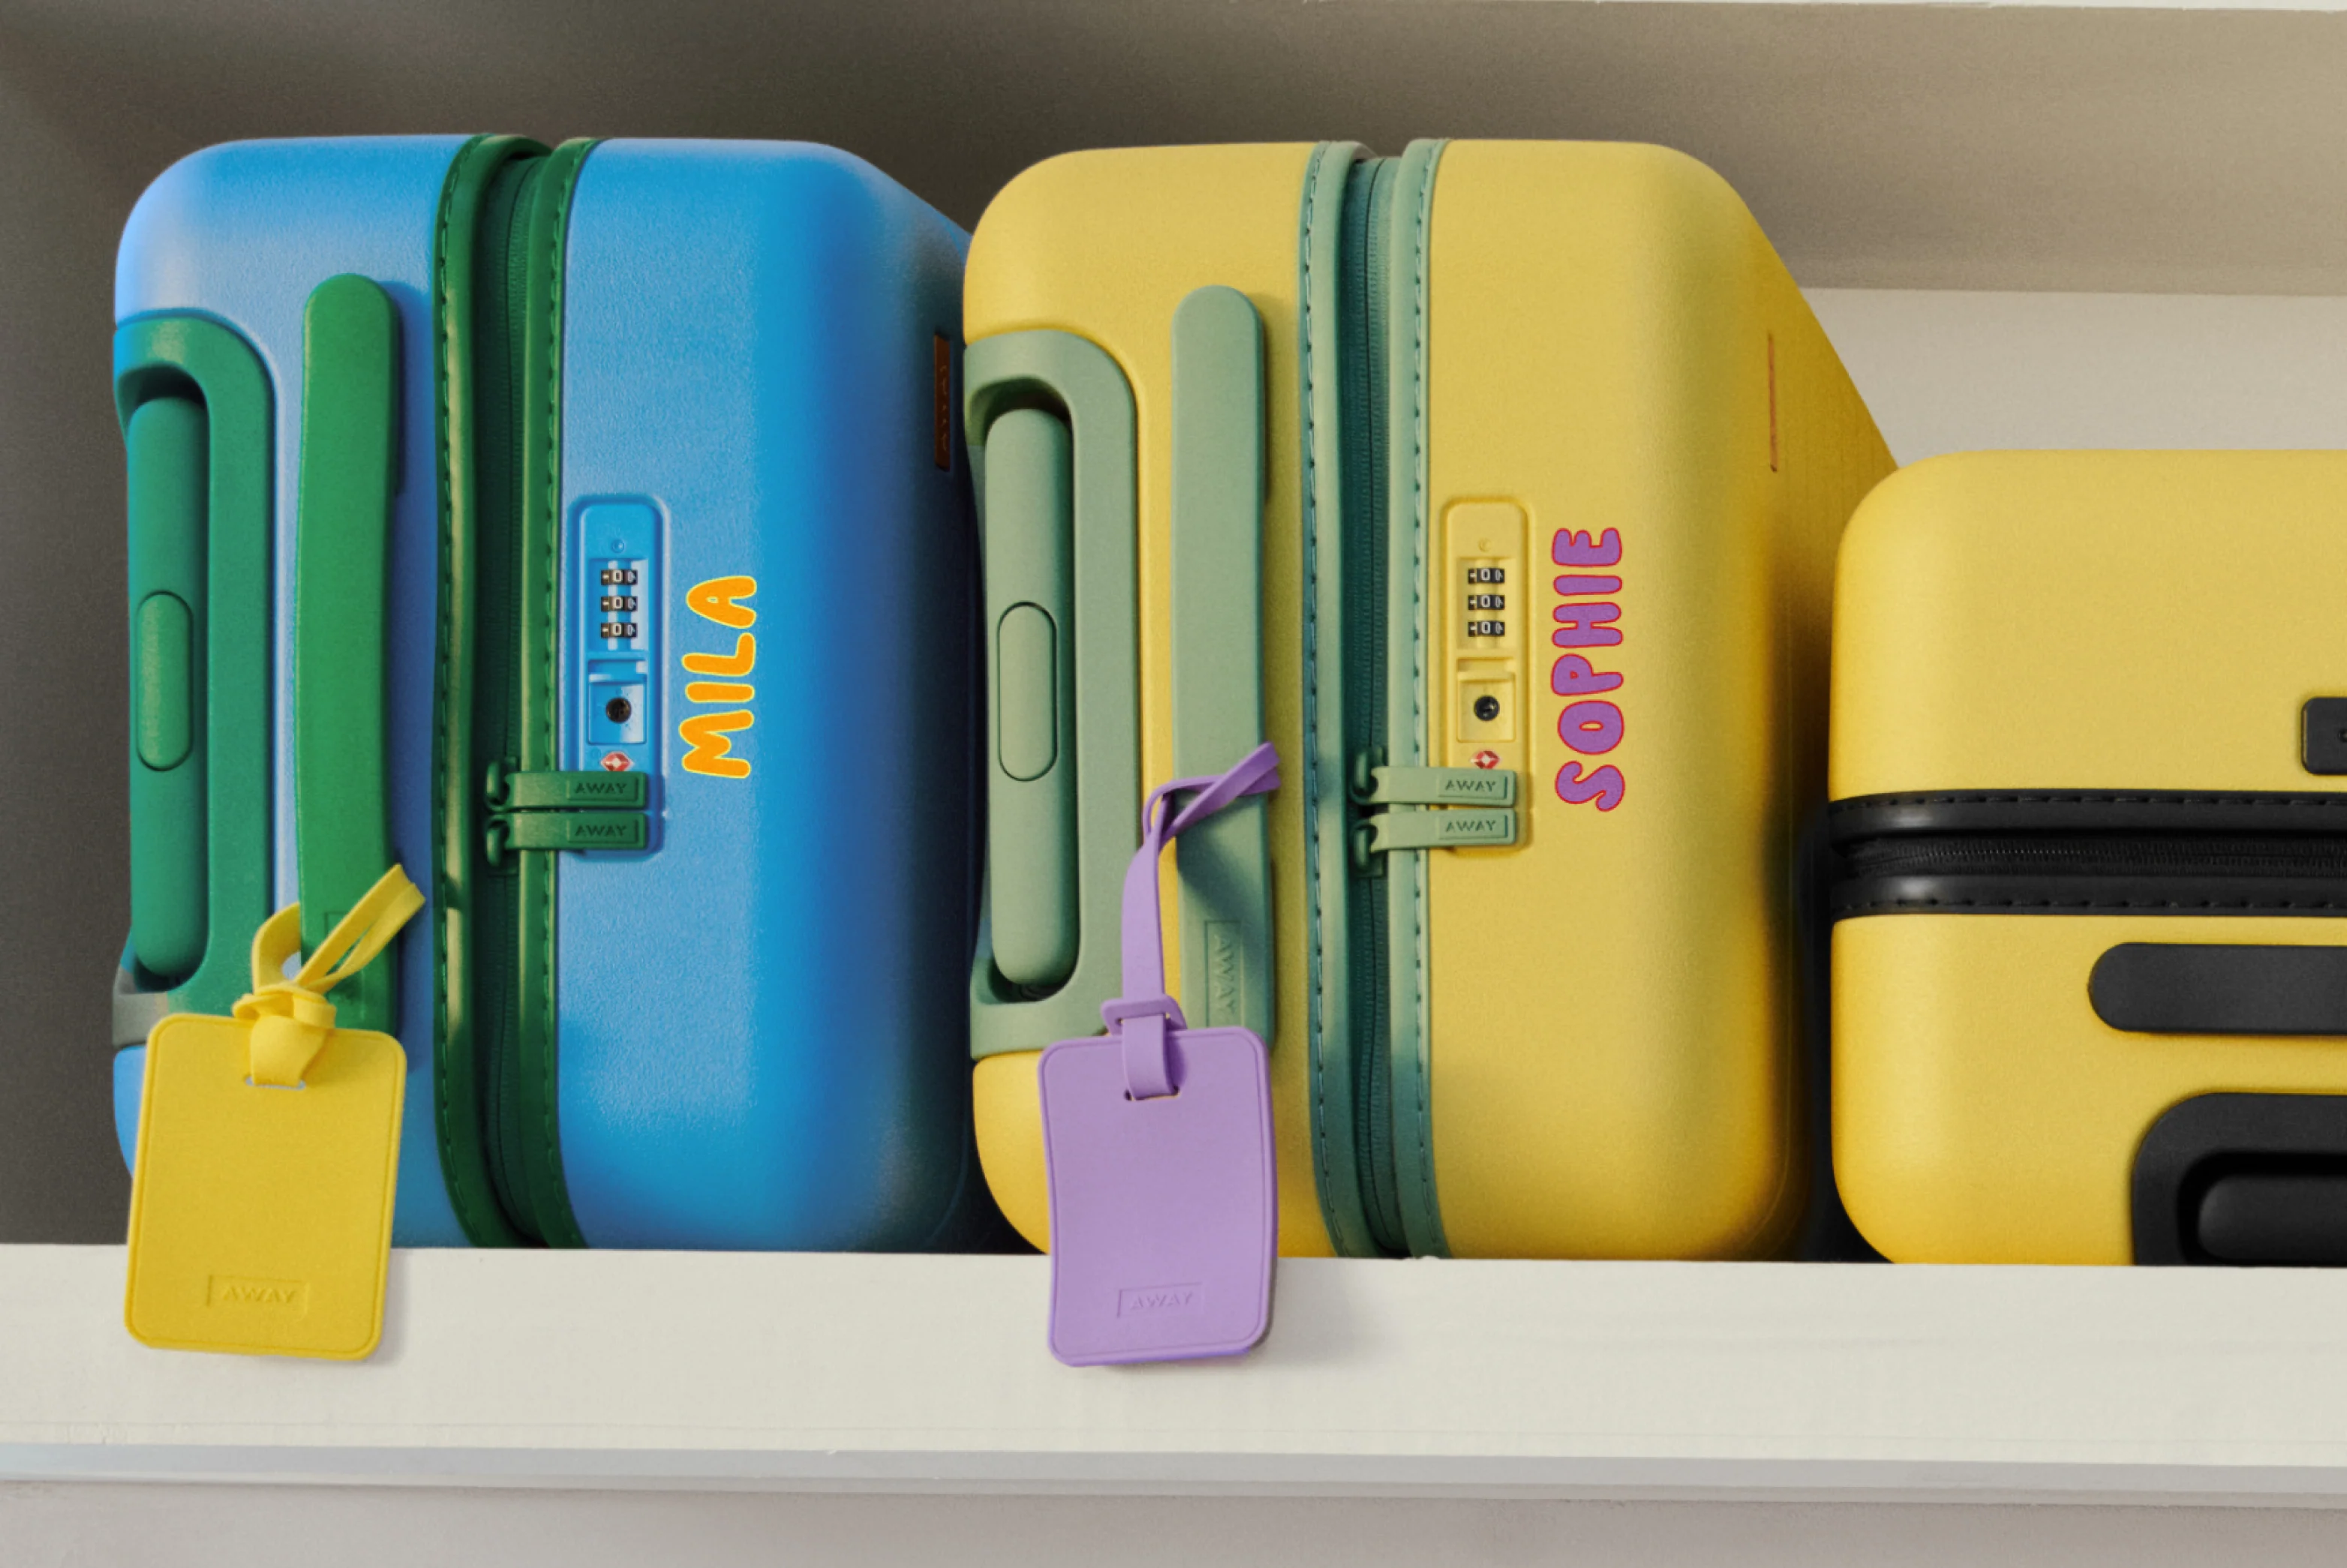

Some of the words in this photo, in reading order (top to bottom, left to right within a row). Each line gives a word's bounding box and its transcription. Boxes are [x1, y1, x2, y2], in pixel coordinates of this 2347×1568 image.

[678, 575, 757, 779] MILA
[1551, 527, 1625, 813] SOPHIE
[574, 782, 627, 795] AWAY
[1445, 779, 1497, 792] AWAY
[574, 825, 627, 837] AWAY
[1445, 819, 1497, 833] AWAY
[1213, 933, 1236, 1015] AWAY
[222, 1285, 296, 1303] AWAY
[1130, 1290, 1194, 1311] AWAY
